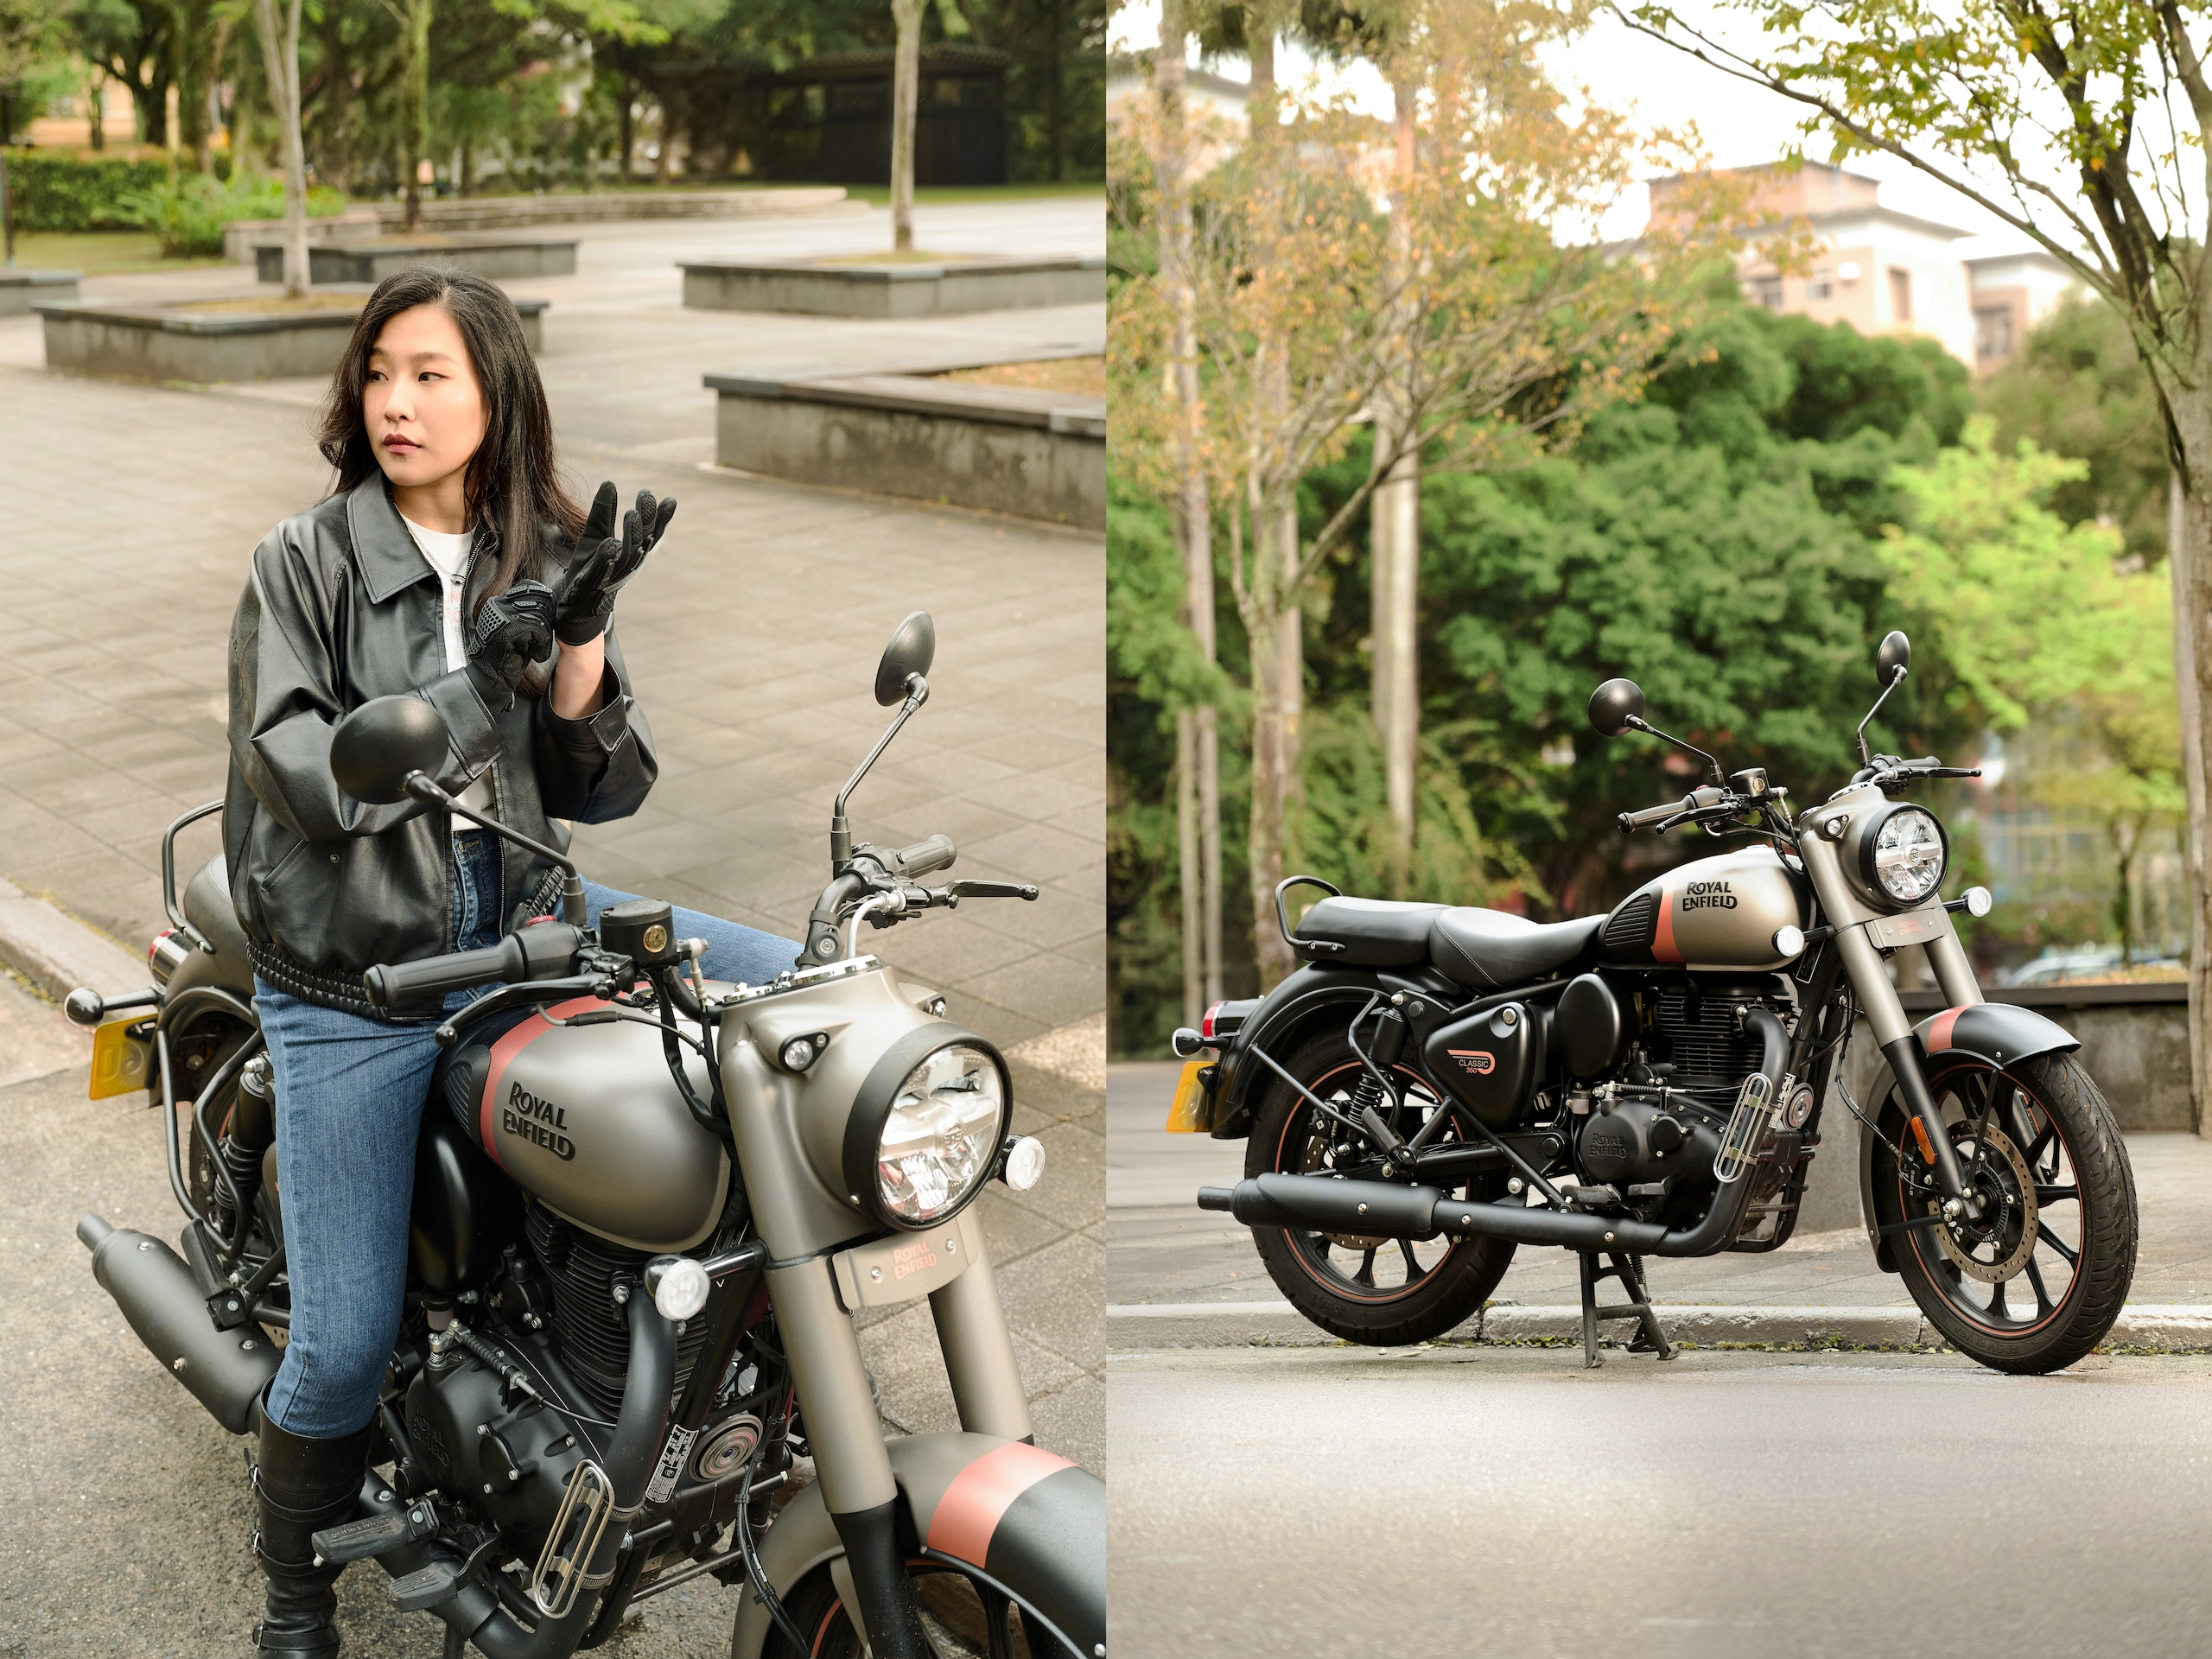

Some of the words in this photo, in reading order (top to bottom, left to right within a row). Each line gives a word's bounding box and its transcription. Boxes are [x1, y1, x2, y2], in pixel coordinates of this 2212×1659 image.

[1687, 881, 1732, 895] ROYAL
[1682, 895, 1738, 912] ENFIELD
[1897, 919, 1918, 929] ROYAL
[1898, 925, 1923, 936] ENFIELD
[1459, 1058, 1489, 1069] CLASSIC
[508, 1080, 568, 1131] ROYAL
[503, 1107, 576, 1161] ENFIELD
[1592, 1133, 1624, 1146] ROYAL
[1589, 1145, 1628, 1159] ENFIELD
[892, 1241, 930, 1264] ROYAL
[893, 1252, 938, 1281] ENFIELD
